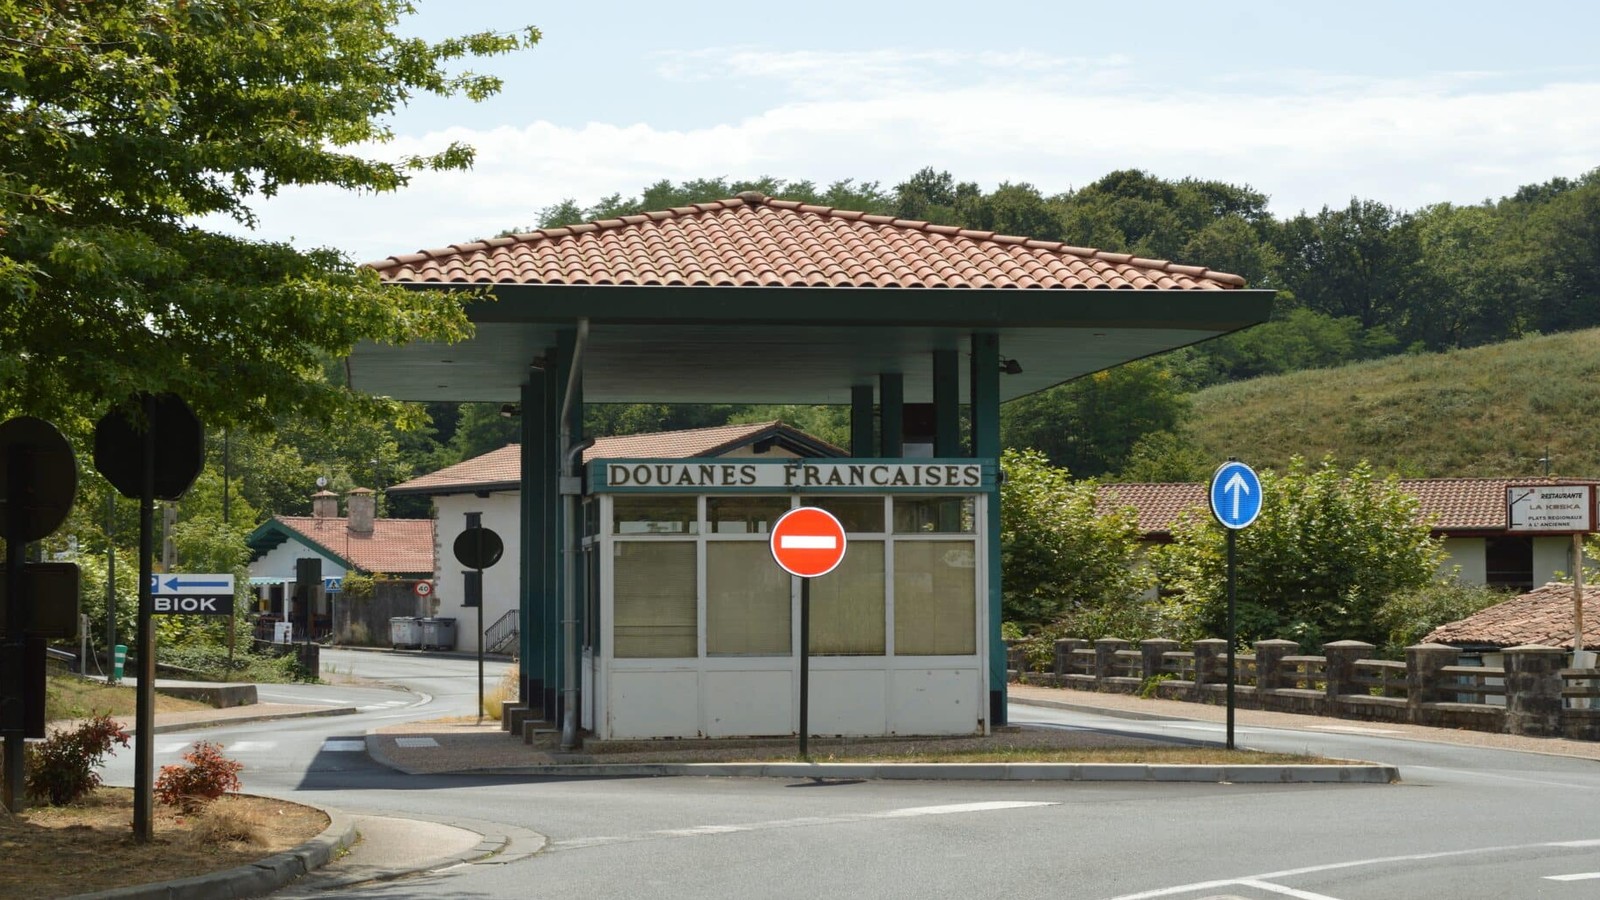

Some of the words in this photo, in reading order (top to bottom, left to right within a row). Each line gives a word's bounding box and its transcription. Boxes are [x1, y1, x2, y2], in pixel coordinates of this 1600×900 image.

[609, 464, 757, 486] DOUANES
[783, 464, 980, 486] FRANCAISES
[154, 597, 217, 611] BIOK
